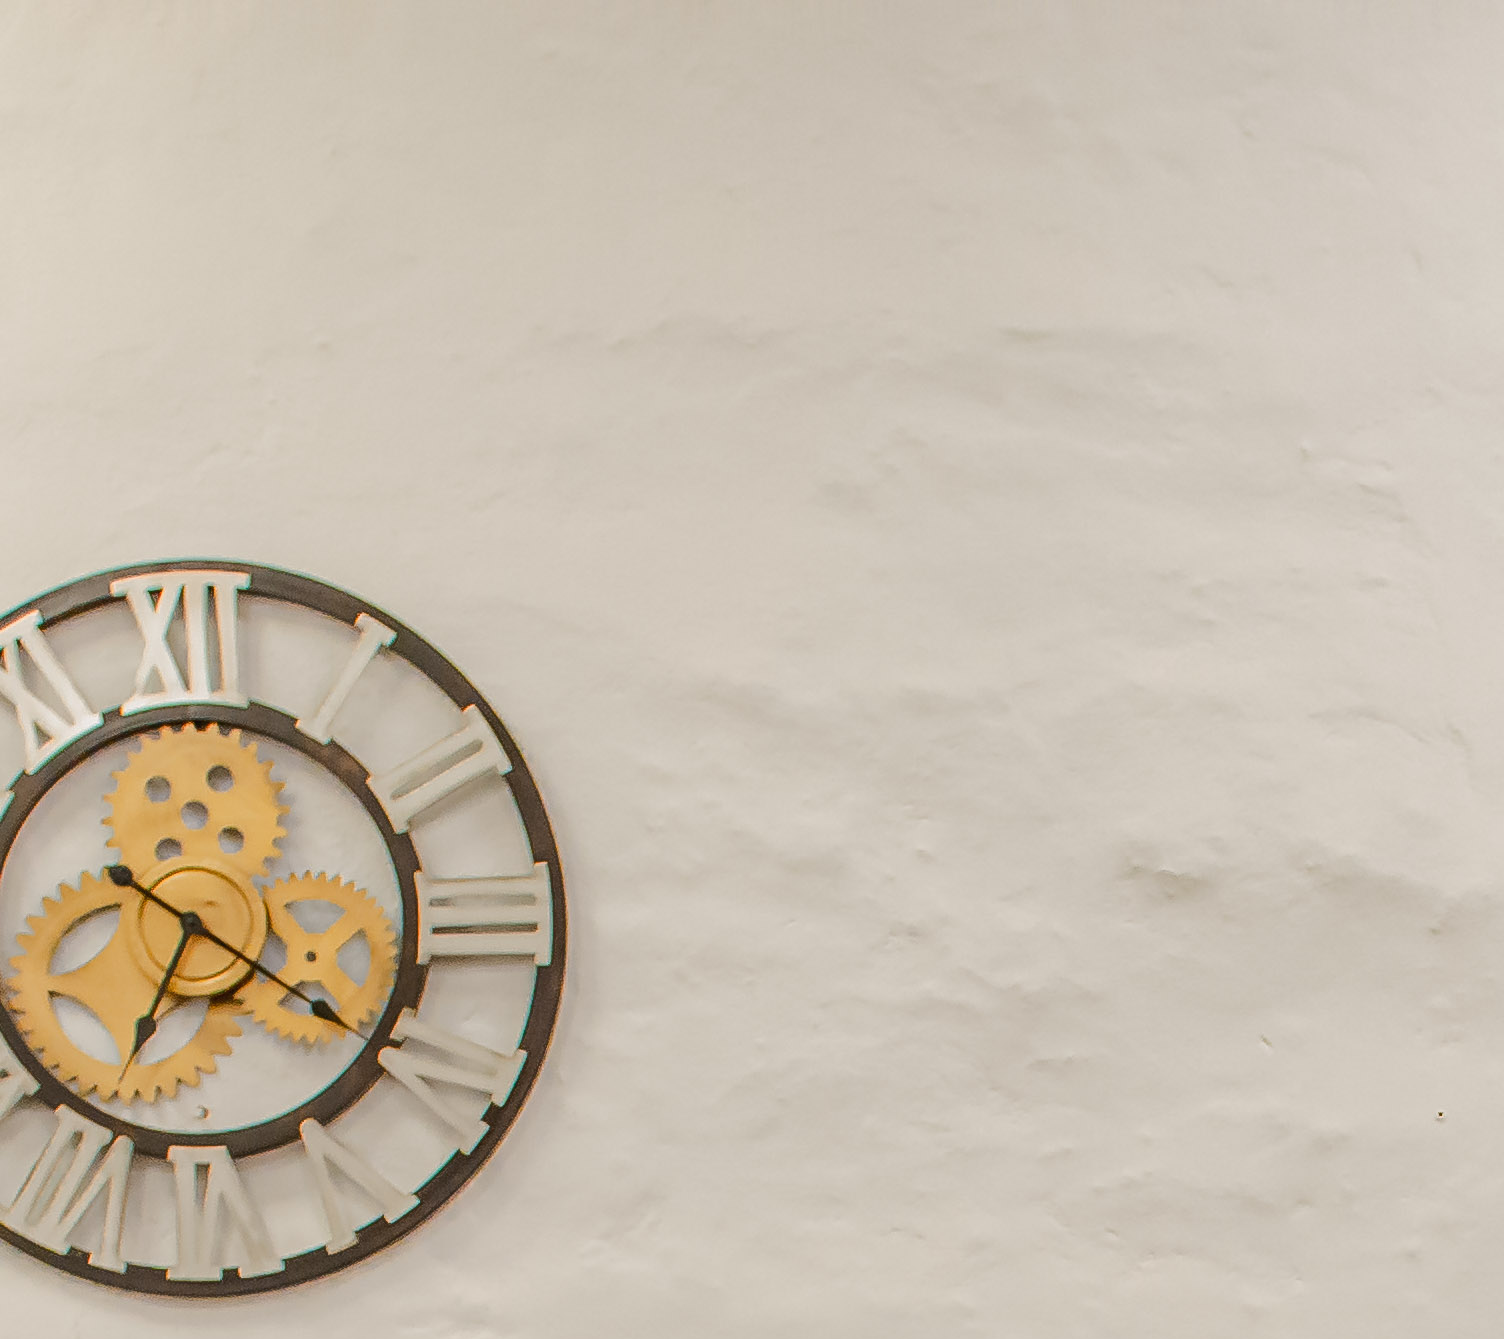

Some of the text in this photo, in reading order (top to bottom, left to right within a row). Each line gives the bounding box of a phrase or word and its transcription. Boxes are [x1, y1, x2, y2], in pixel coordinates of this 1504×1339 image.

[110, 571, 250, 716] XII
[296, 612, 396, 744] I
[366, 704, 511, 833] II
[414, 861, 552, 965] III
[378, 1007, 526, 1154] IV
[166, 1145, 285, 1281] VI
[300, 1118, 420, 1254] V
